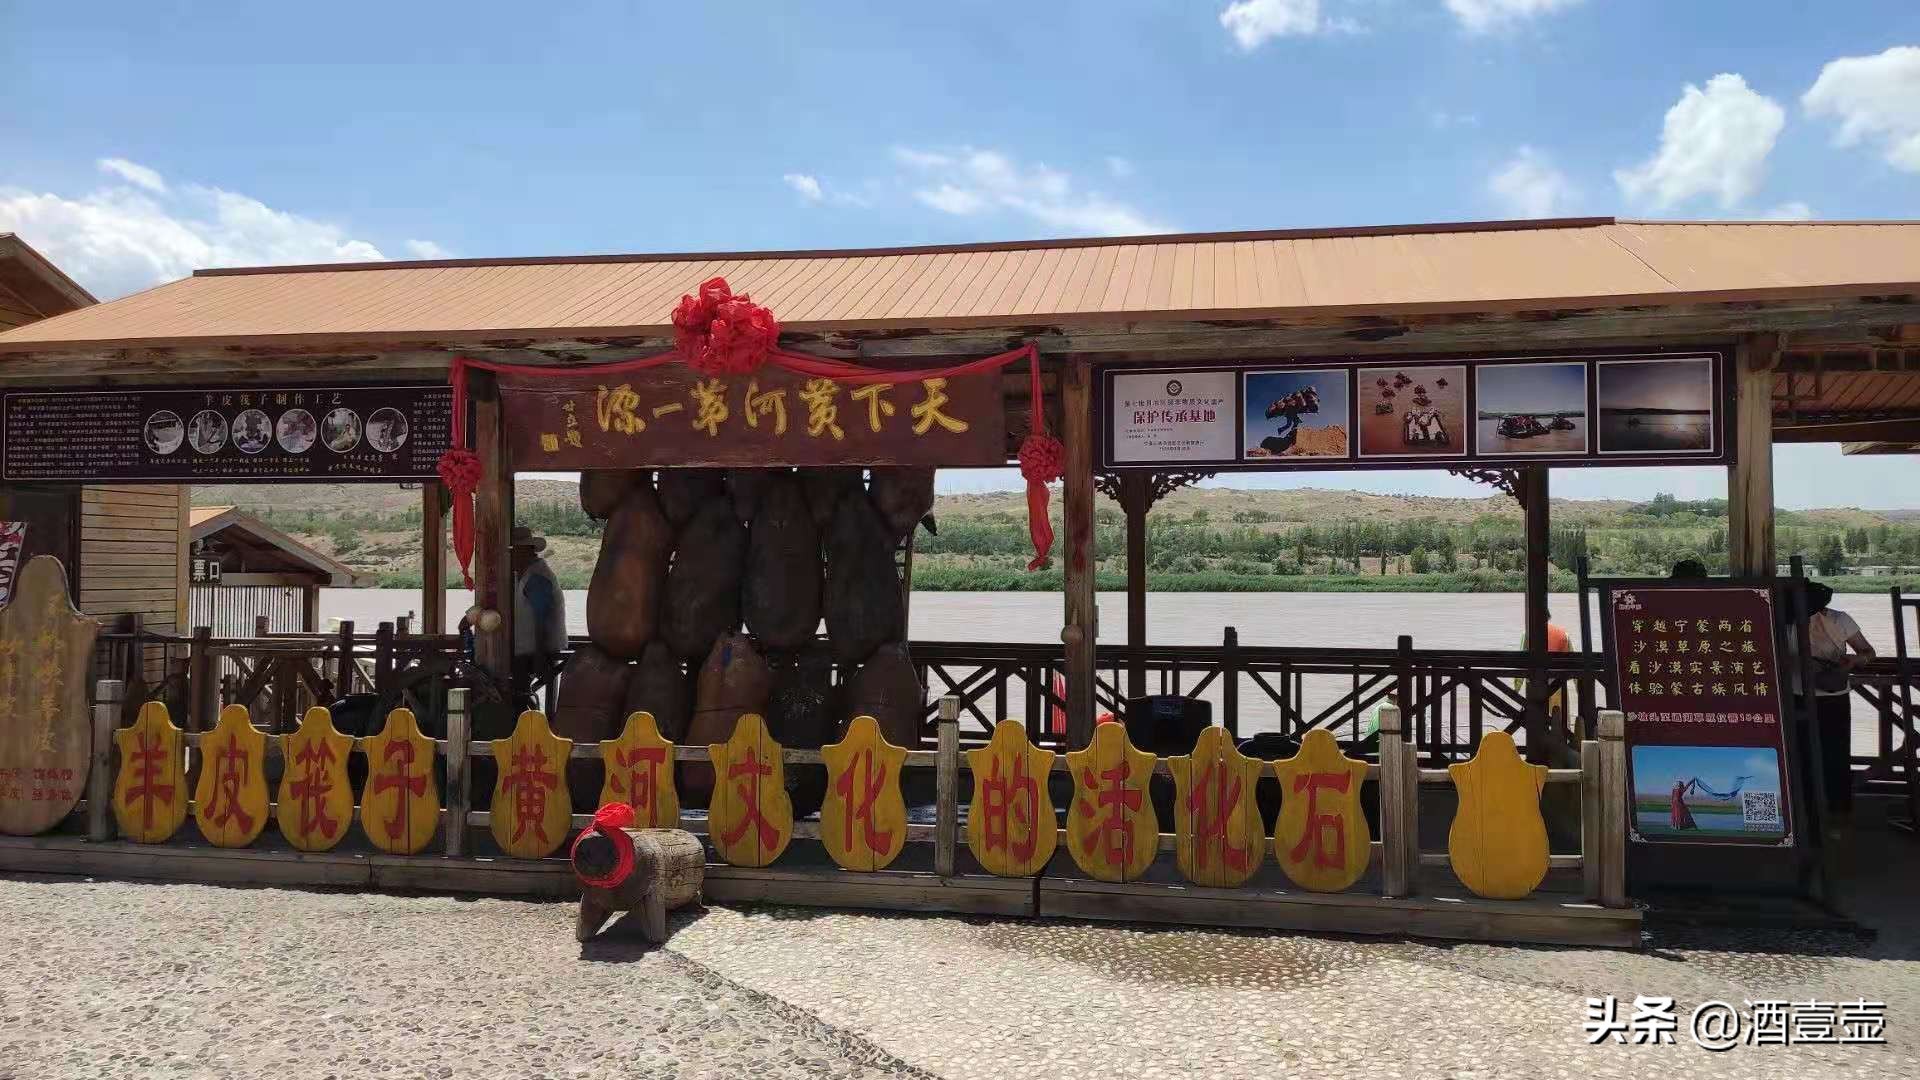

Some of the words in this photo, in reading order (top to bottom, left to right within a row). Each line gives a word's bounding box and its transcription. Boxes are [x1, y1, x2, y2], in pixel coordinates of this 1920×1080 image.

[1133, 409, 1216, 424] 保护传承基地
[1632, 619, 1753, 633] 穿越宁蒙两省
[1633, 640, 1757, 654] 沙漠草原之旅
[1628, 661, 1766, 675] 看沙漠实景演艺
[1628, 682, 1769, 696] 体验蒙古族风情
